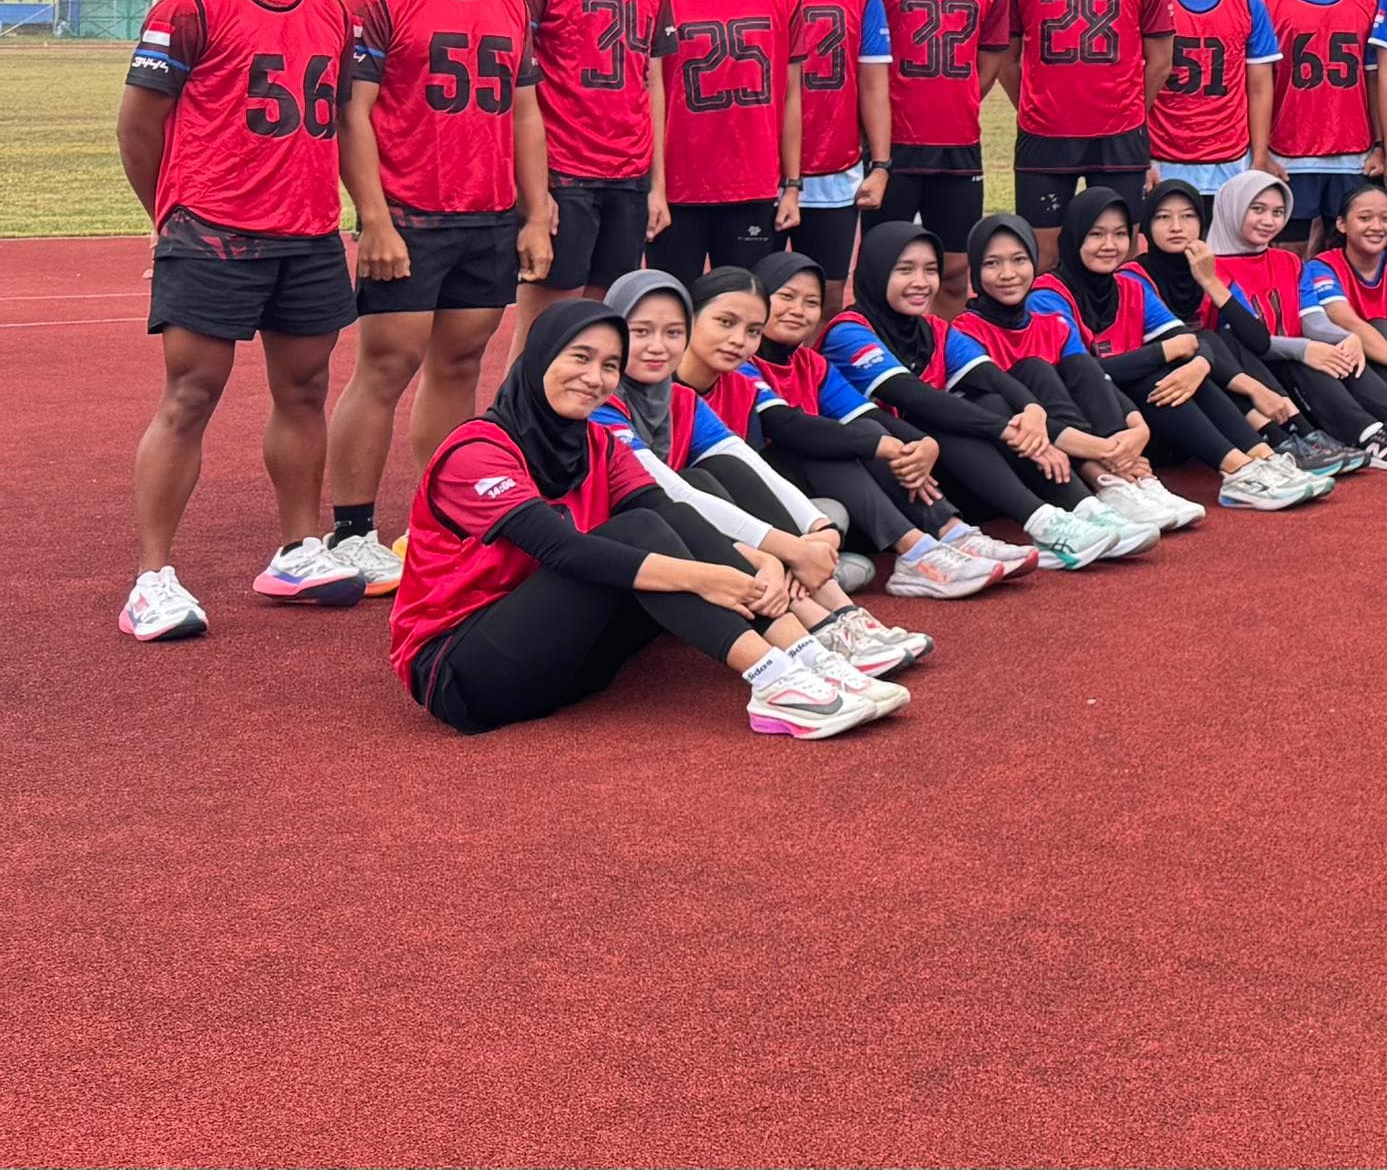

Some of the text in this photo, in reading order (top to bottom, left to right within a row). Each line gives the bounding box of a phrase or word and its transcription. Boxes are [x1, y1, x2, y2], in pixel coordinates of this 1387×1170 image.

[425, 32, 513, 116] 55
[679, 16, 773, 113] 25
[803, 5, 848, 91] 3
[1168, 35, 1228, 97] 51
[1291, 32, 1360, 90] 65
[245, 53, 338, 140] 56
